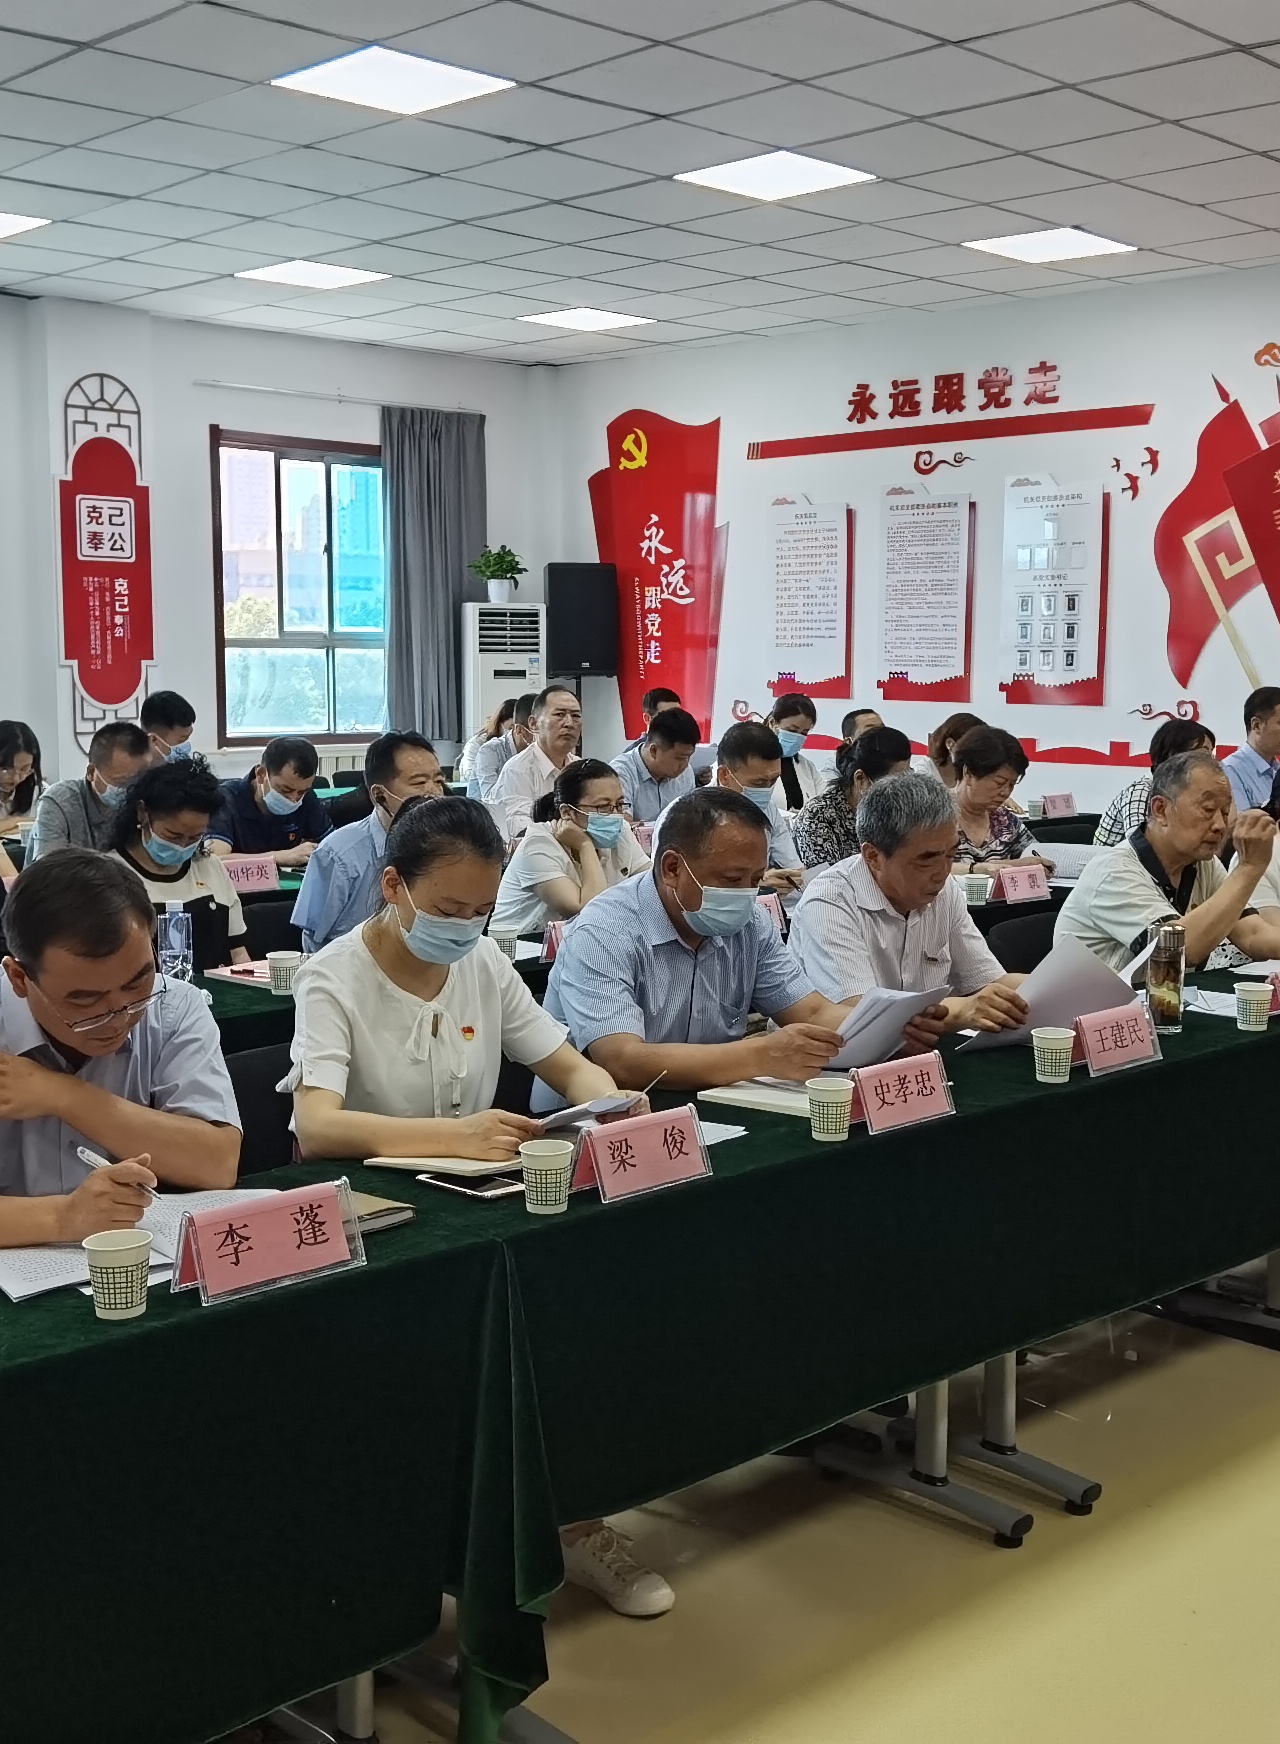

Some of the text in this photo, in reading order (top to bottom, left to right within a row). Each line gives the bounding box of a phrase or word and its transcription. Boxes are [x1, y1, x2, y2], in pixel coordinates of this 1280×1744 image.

[847, 361, 1061, 424] 永远跟党走
[639, 514, 696, 605] 永远
[644, 586, 662, 665] 跟党走
[1093, 1017, 1146, 1054] 王建民
[873, 1069, 937, 1111] 史孝忠
[607, 1125, 690, 1175] 梁俊
[214, 1203, 330, 1266] 李蓬
